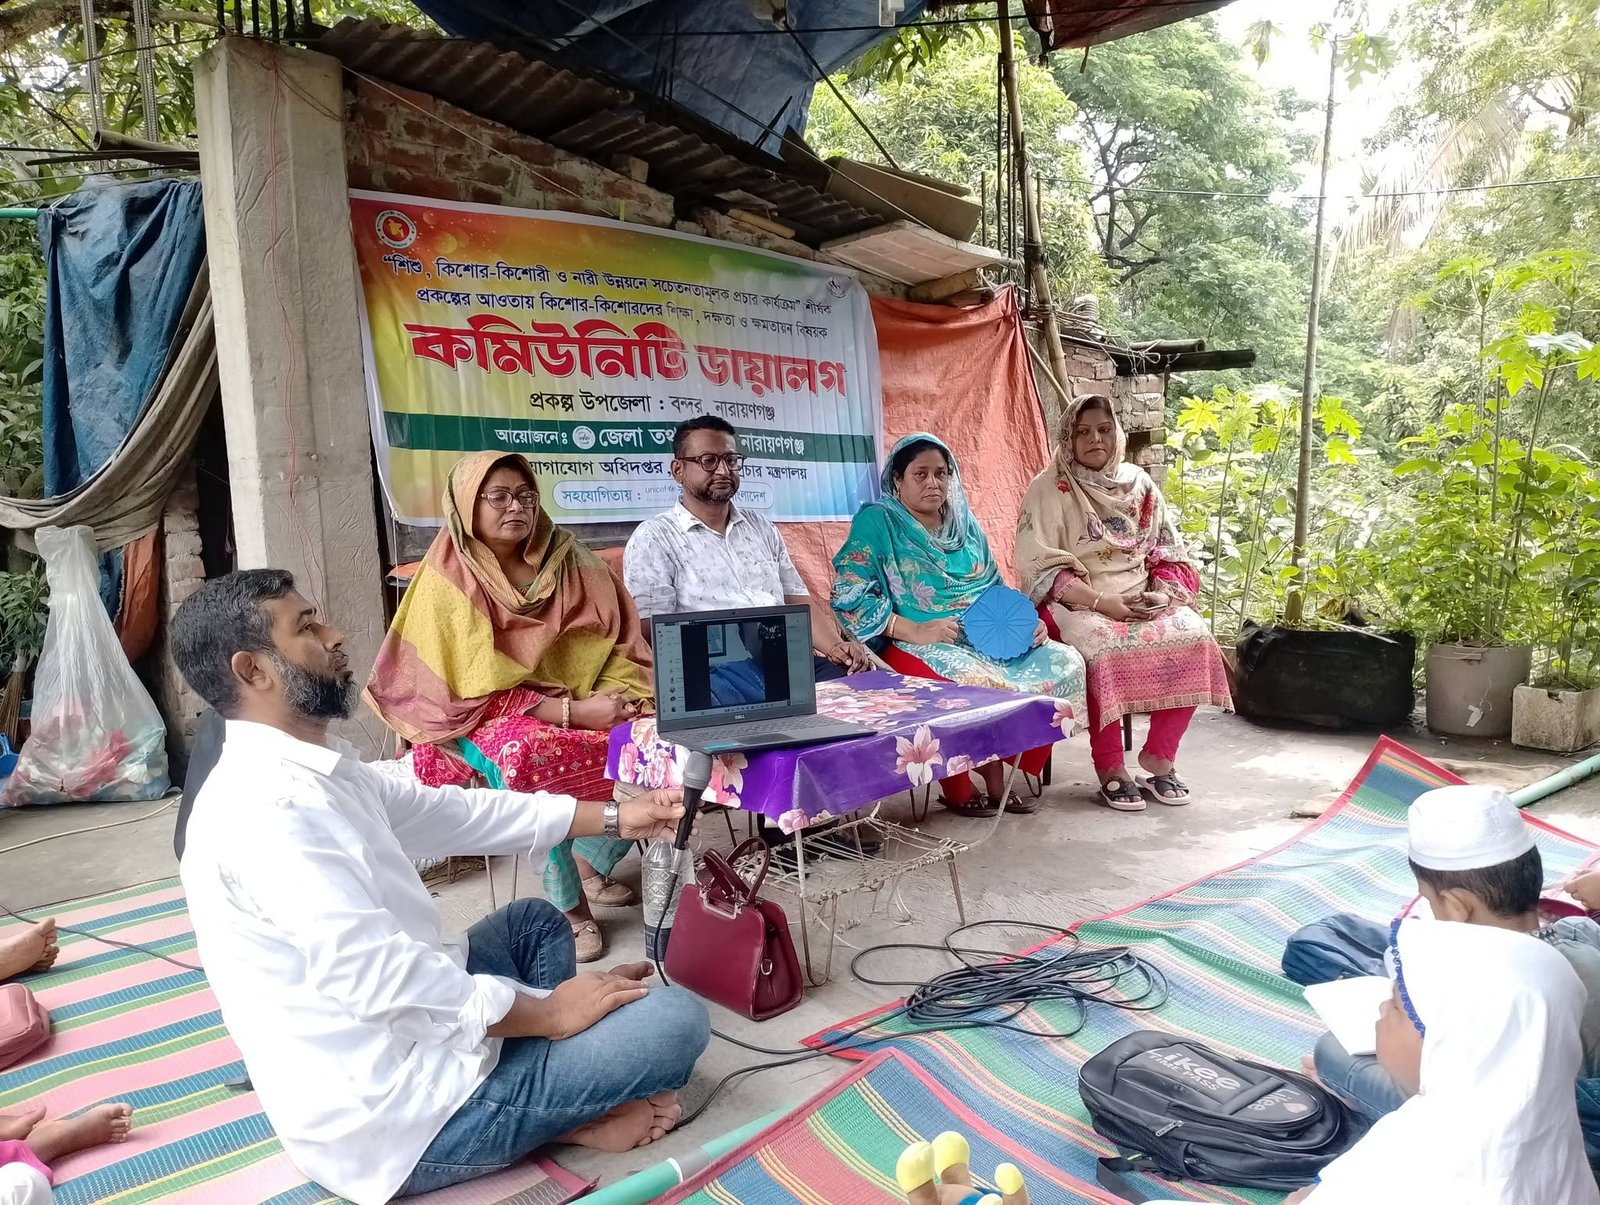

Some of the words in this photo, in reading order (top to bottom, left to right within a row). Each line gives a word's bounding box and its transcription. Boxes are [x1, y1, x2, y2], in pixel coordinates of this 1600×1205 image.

[435, 256, 550, 283] কিশোর-কিশোরী
[555, 271, 568, 283] ও
[571, 268, 600, 287] নারী
[602, 271, 648, 291] উন্নয়নে
[650, 278, 730, 304] সচেতনতামূলক
[733, 291, 758, 306] প্রচার
[804, 299, 832, 315] শীর্ষক
[416, 288, 471, 306] প্রকল্পের
[476, 292, 535, 310] আওতায়
[540, 292, 663, 317] কিশোর-কিশোরদের
[702, 310, 736, 327] দক্ষতা
[740, 317, 748, 328] ও
[750, 317, 793, 336] ক্ষমতায়ন
[796, 320, 828, 339] বিষয়ক
[402, 313, 688, 381] কমিউনিটি
[694, 344, 848, 398] ডায়ালগ
[529, 391, 575, 413] প্রকল্প
[578, 388, 652, 413] উপজেলা
[713, 400, 776, 422] নারায়ণগঞ্জ
[599, 426, 645, 448] জেলা
[738, 433, 806, 456] নারায়ণগঞ্জ
[765, 465, 808, 481] মন্ত্রণালয়
[561, 486, 633, 503] সহযোগিতায়
[1149, 1054, 1184, 1073] TIME
[1183, 1070, 1222, 1091] PASS
